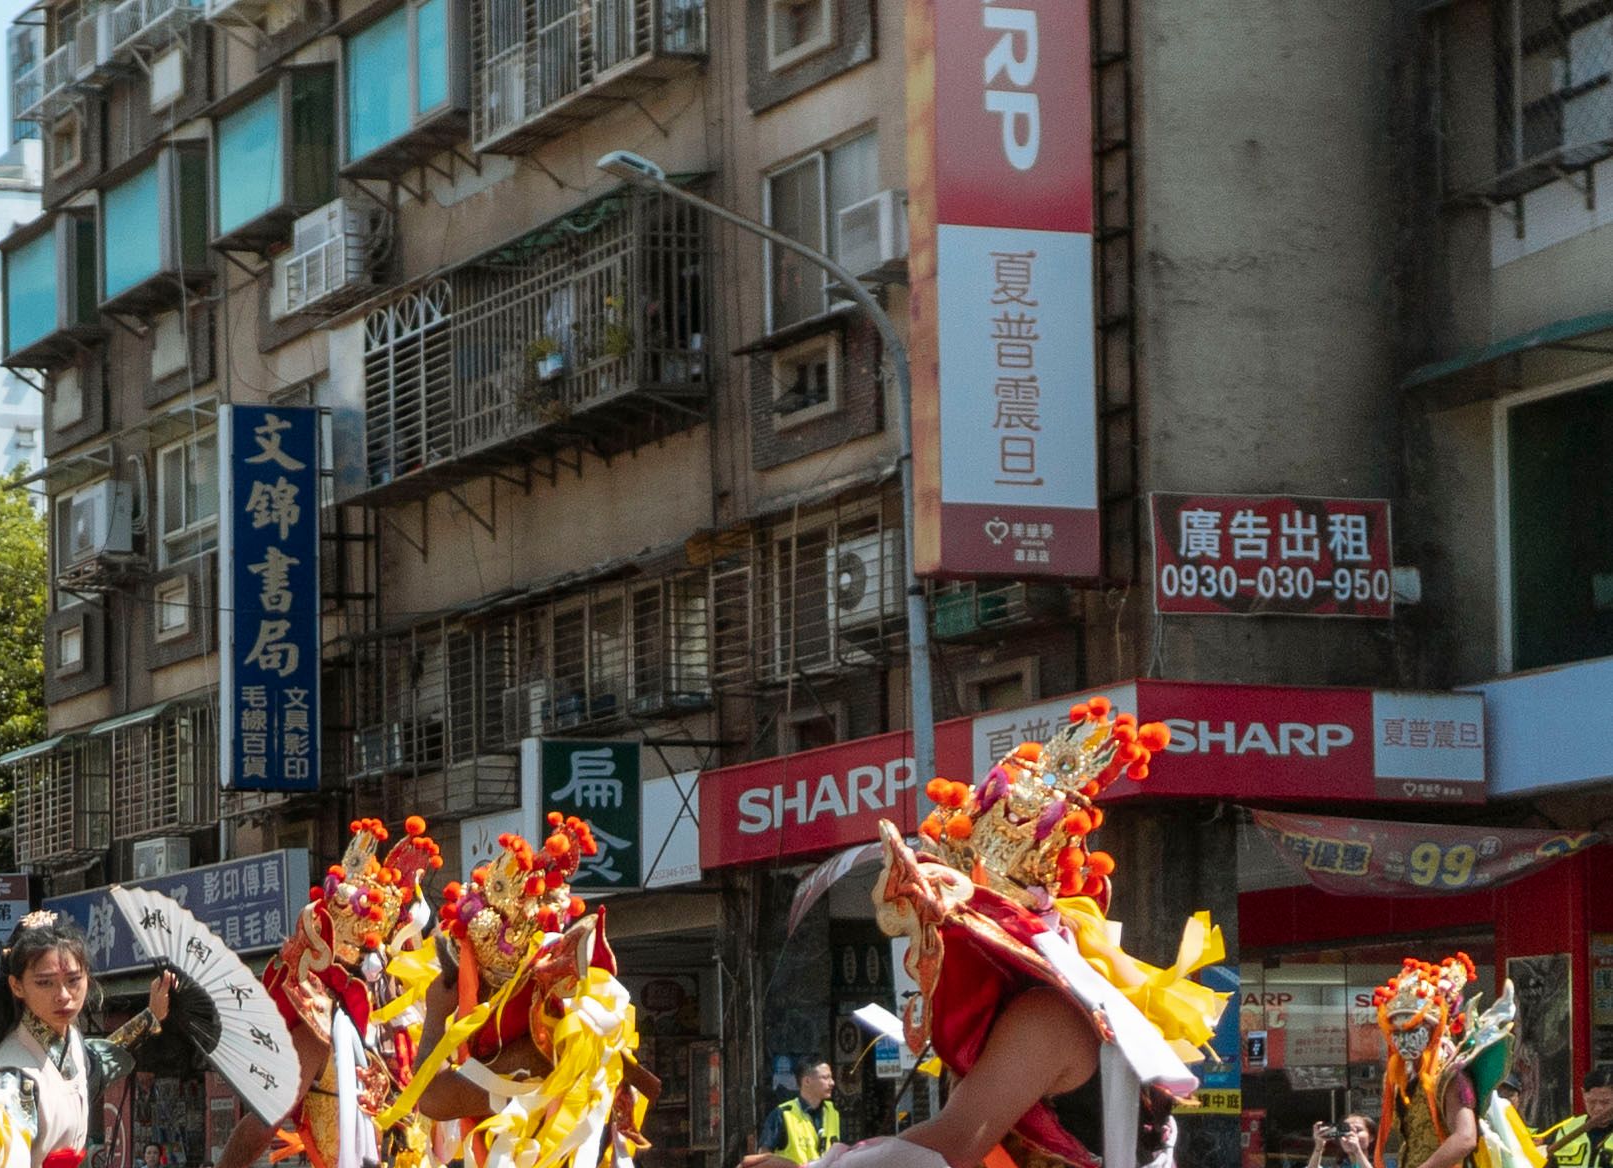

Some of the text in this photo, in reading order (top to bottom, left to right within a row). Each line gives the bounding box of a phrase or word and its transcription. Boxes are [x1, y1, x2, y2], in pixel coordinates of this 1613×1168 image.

[982, 0, 1041, 171] RP
[988, 249, 1045, 488] 夏普震旦
[243, 412, 306, 678] 文錦書局
[1177, 507, 1373, 566] 廣告出租
[1160, 563, 1390, 602] 0930-030-950
[241, 684, 268, 779] 毛線百貨
[283, 685, 310, 780] 文具影印
[1162, 717, 1354, 758] SHARP
[1382, 717, 1483, 750] 夏普震旦
[737, 757, 918, 835] SHARP
[202, 860, 282, 905] 影印傳真
[1410, 842, 1476, 887] 99
